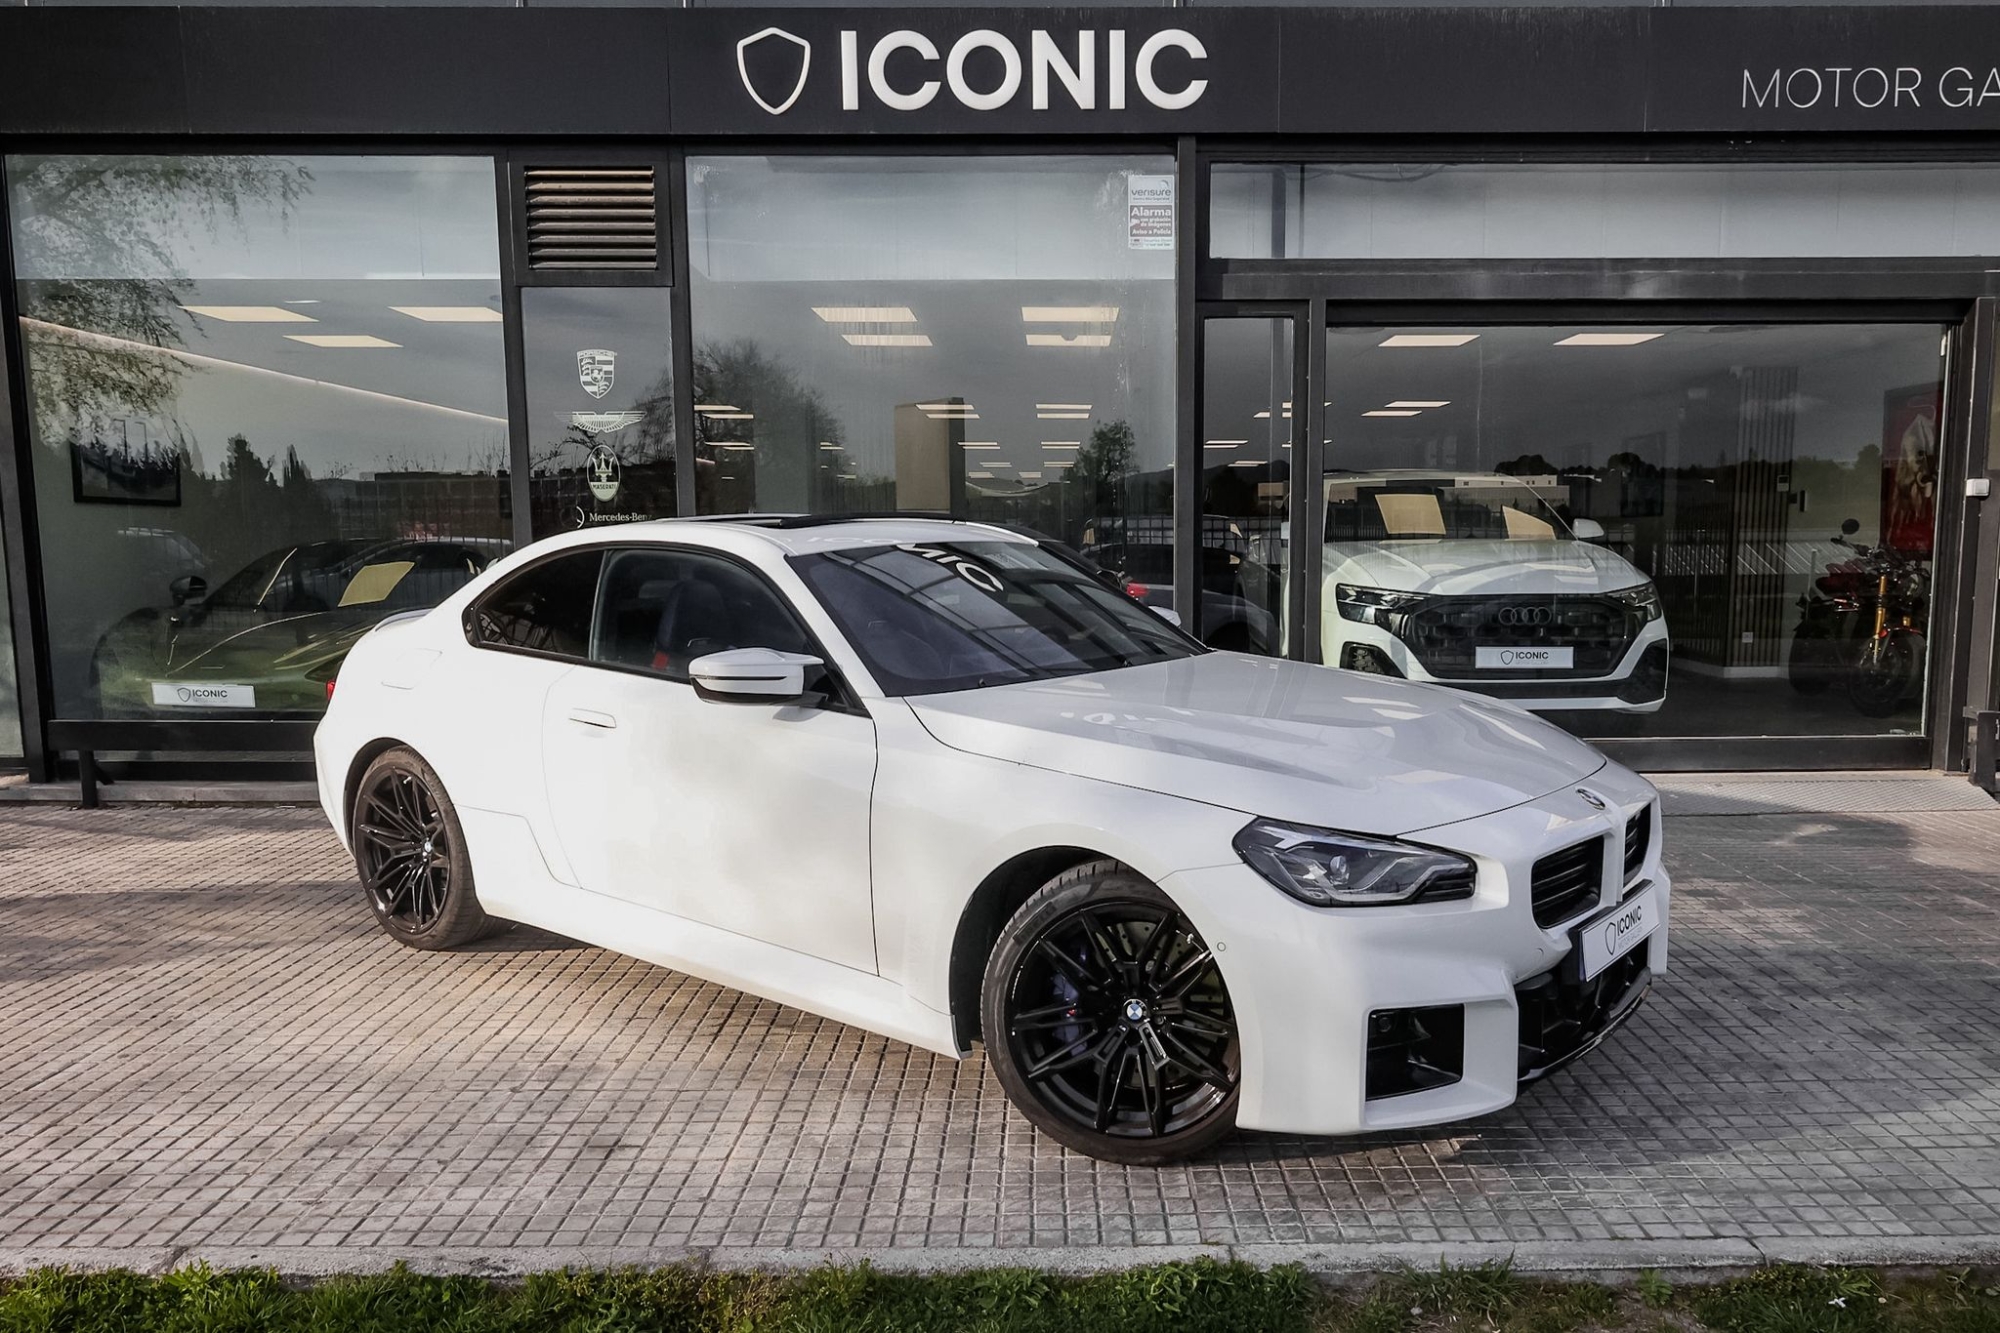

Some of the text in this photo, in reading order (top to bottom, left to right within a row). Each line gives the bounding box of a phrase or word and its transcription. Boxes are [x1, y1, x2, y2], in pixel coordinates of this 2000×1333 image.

[840, 29, 1209, 111] ICONIC
[1741, 67, 1921, 109] MOTOR
[1131, 206, 1172, 216] Alarma
[1515, 651, 1549, 660] ICONIC
[192, 689, 228, 698] ICONIC
[1616, 905, 1642, 936] ICONIC
